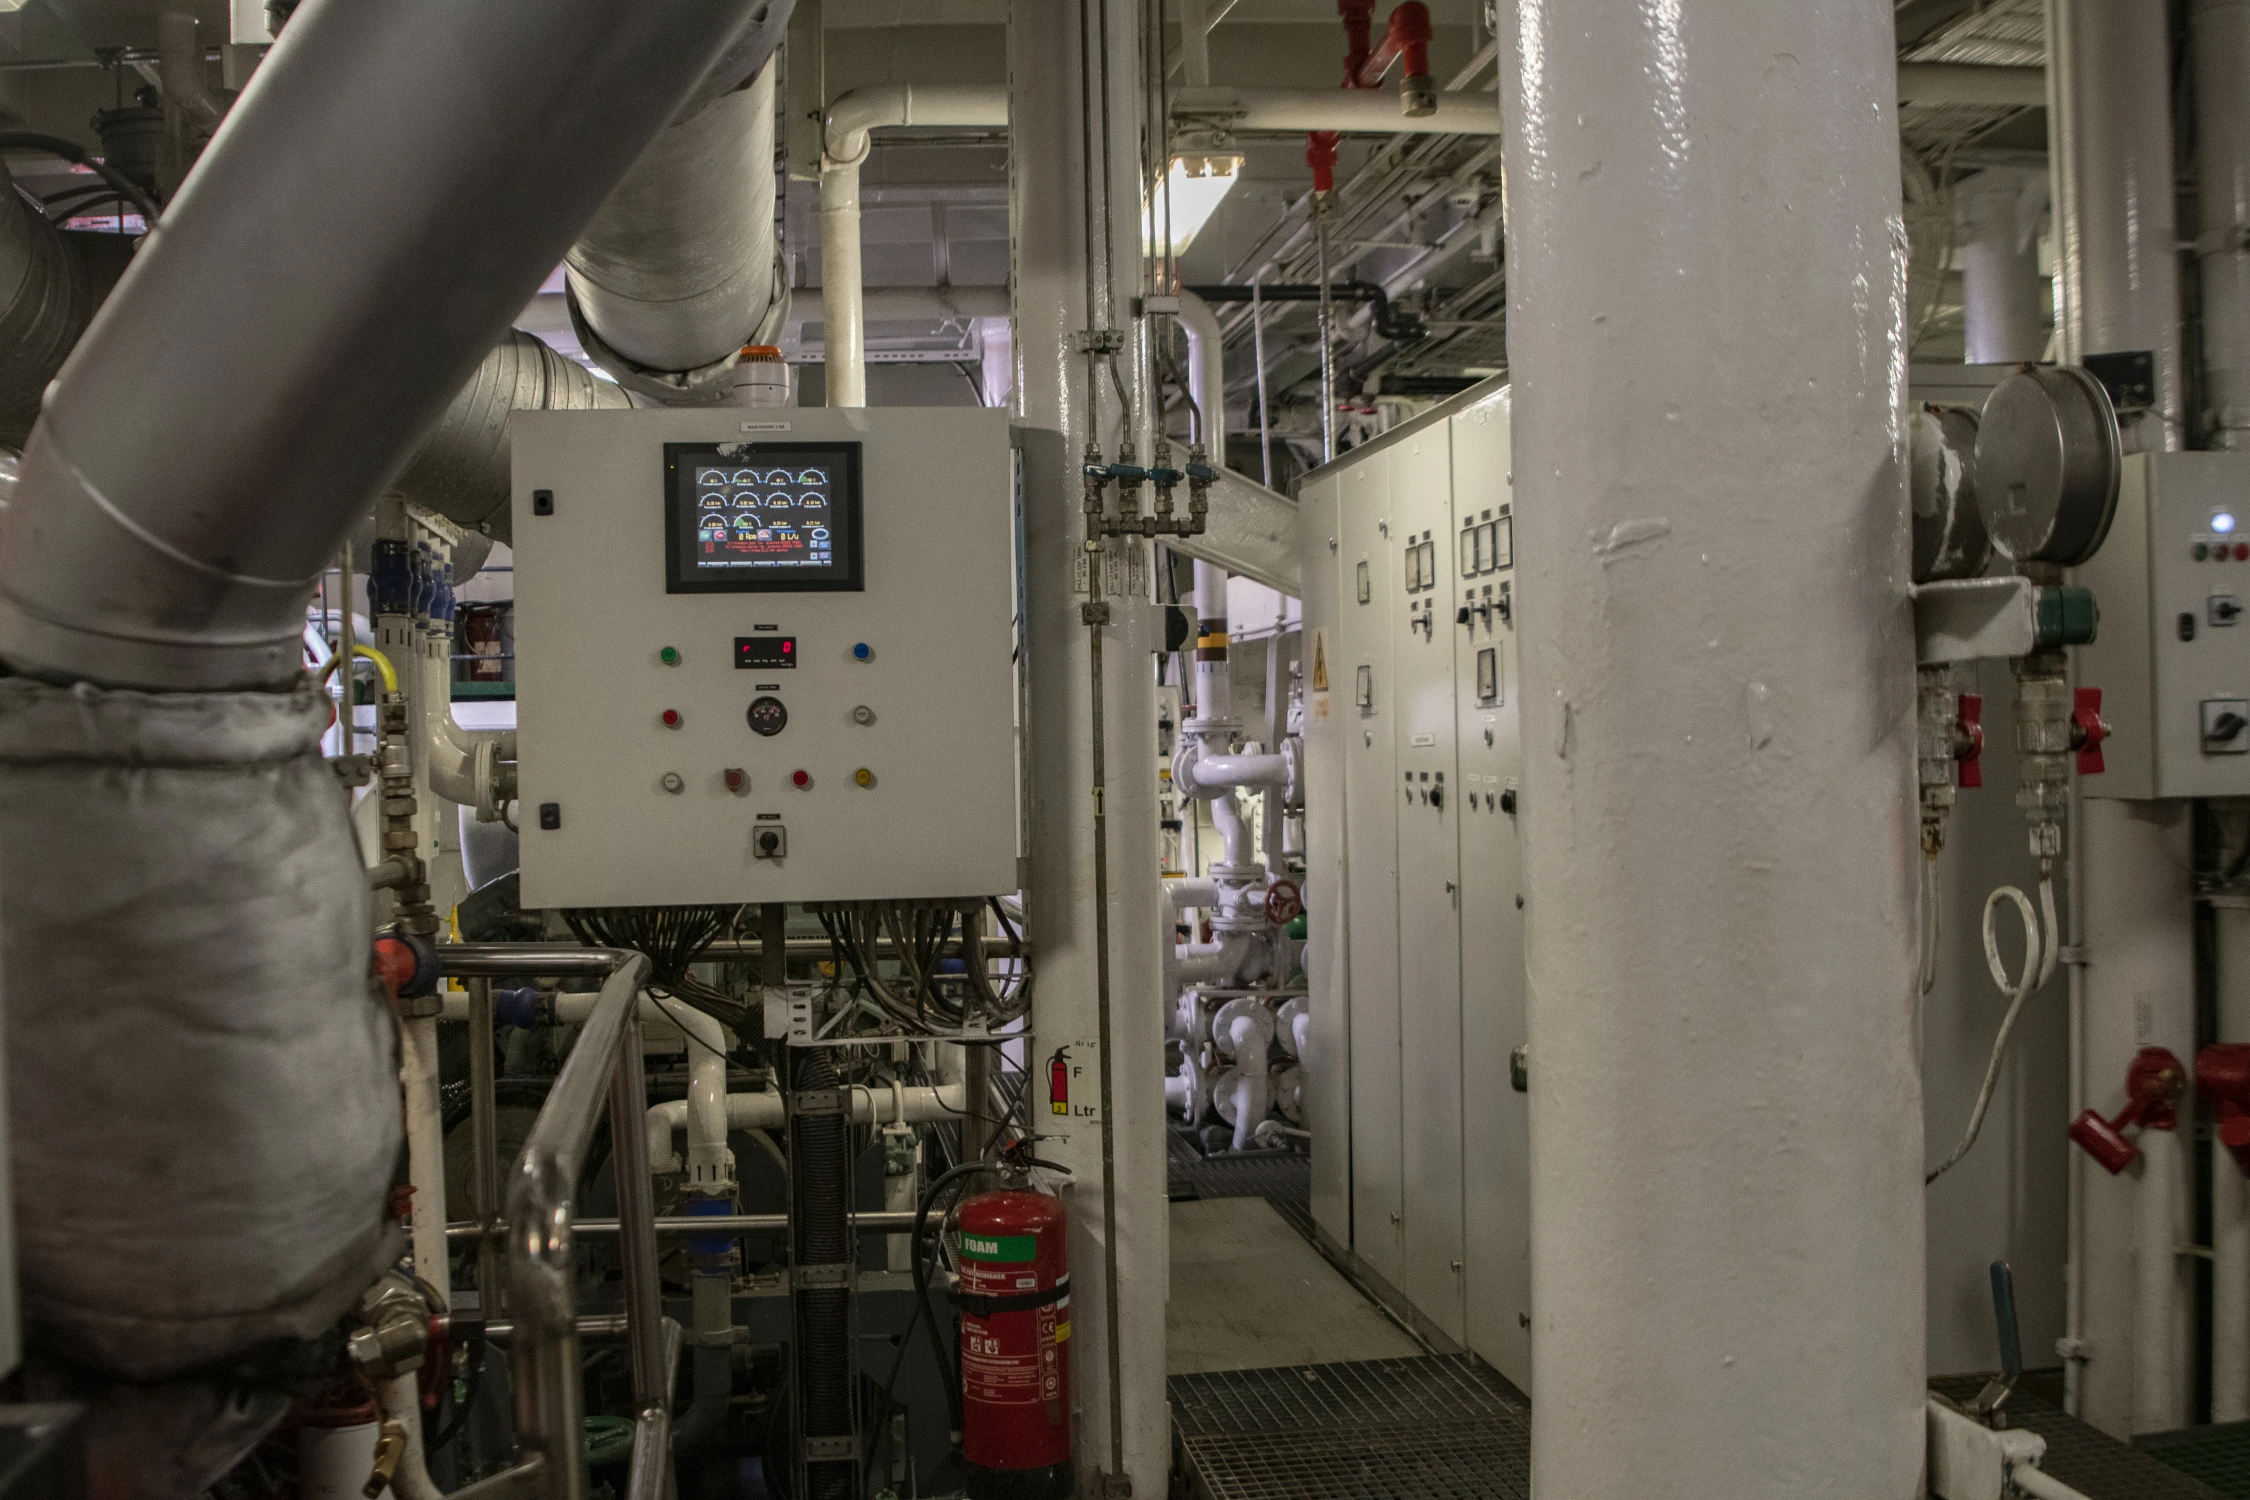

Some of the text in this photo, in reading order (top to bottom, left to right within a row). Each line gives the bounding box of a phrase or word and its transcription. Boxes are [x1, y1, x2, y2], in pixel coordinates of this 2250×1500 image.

[745, 533, 757, 541] Rpm
[782, 641, 792, 653] 0
[1073, 1066, 1082, 1078] F
[1074, 1104, 1096, 1117] Ltr
[965, 1237, 998, 1254] FOAM
